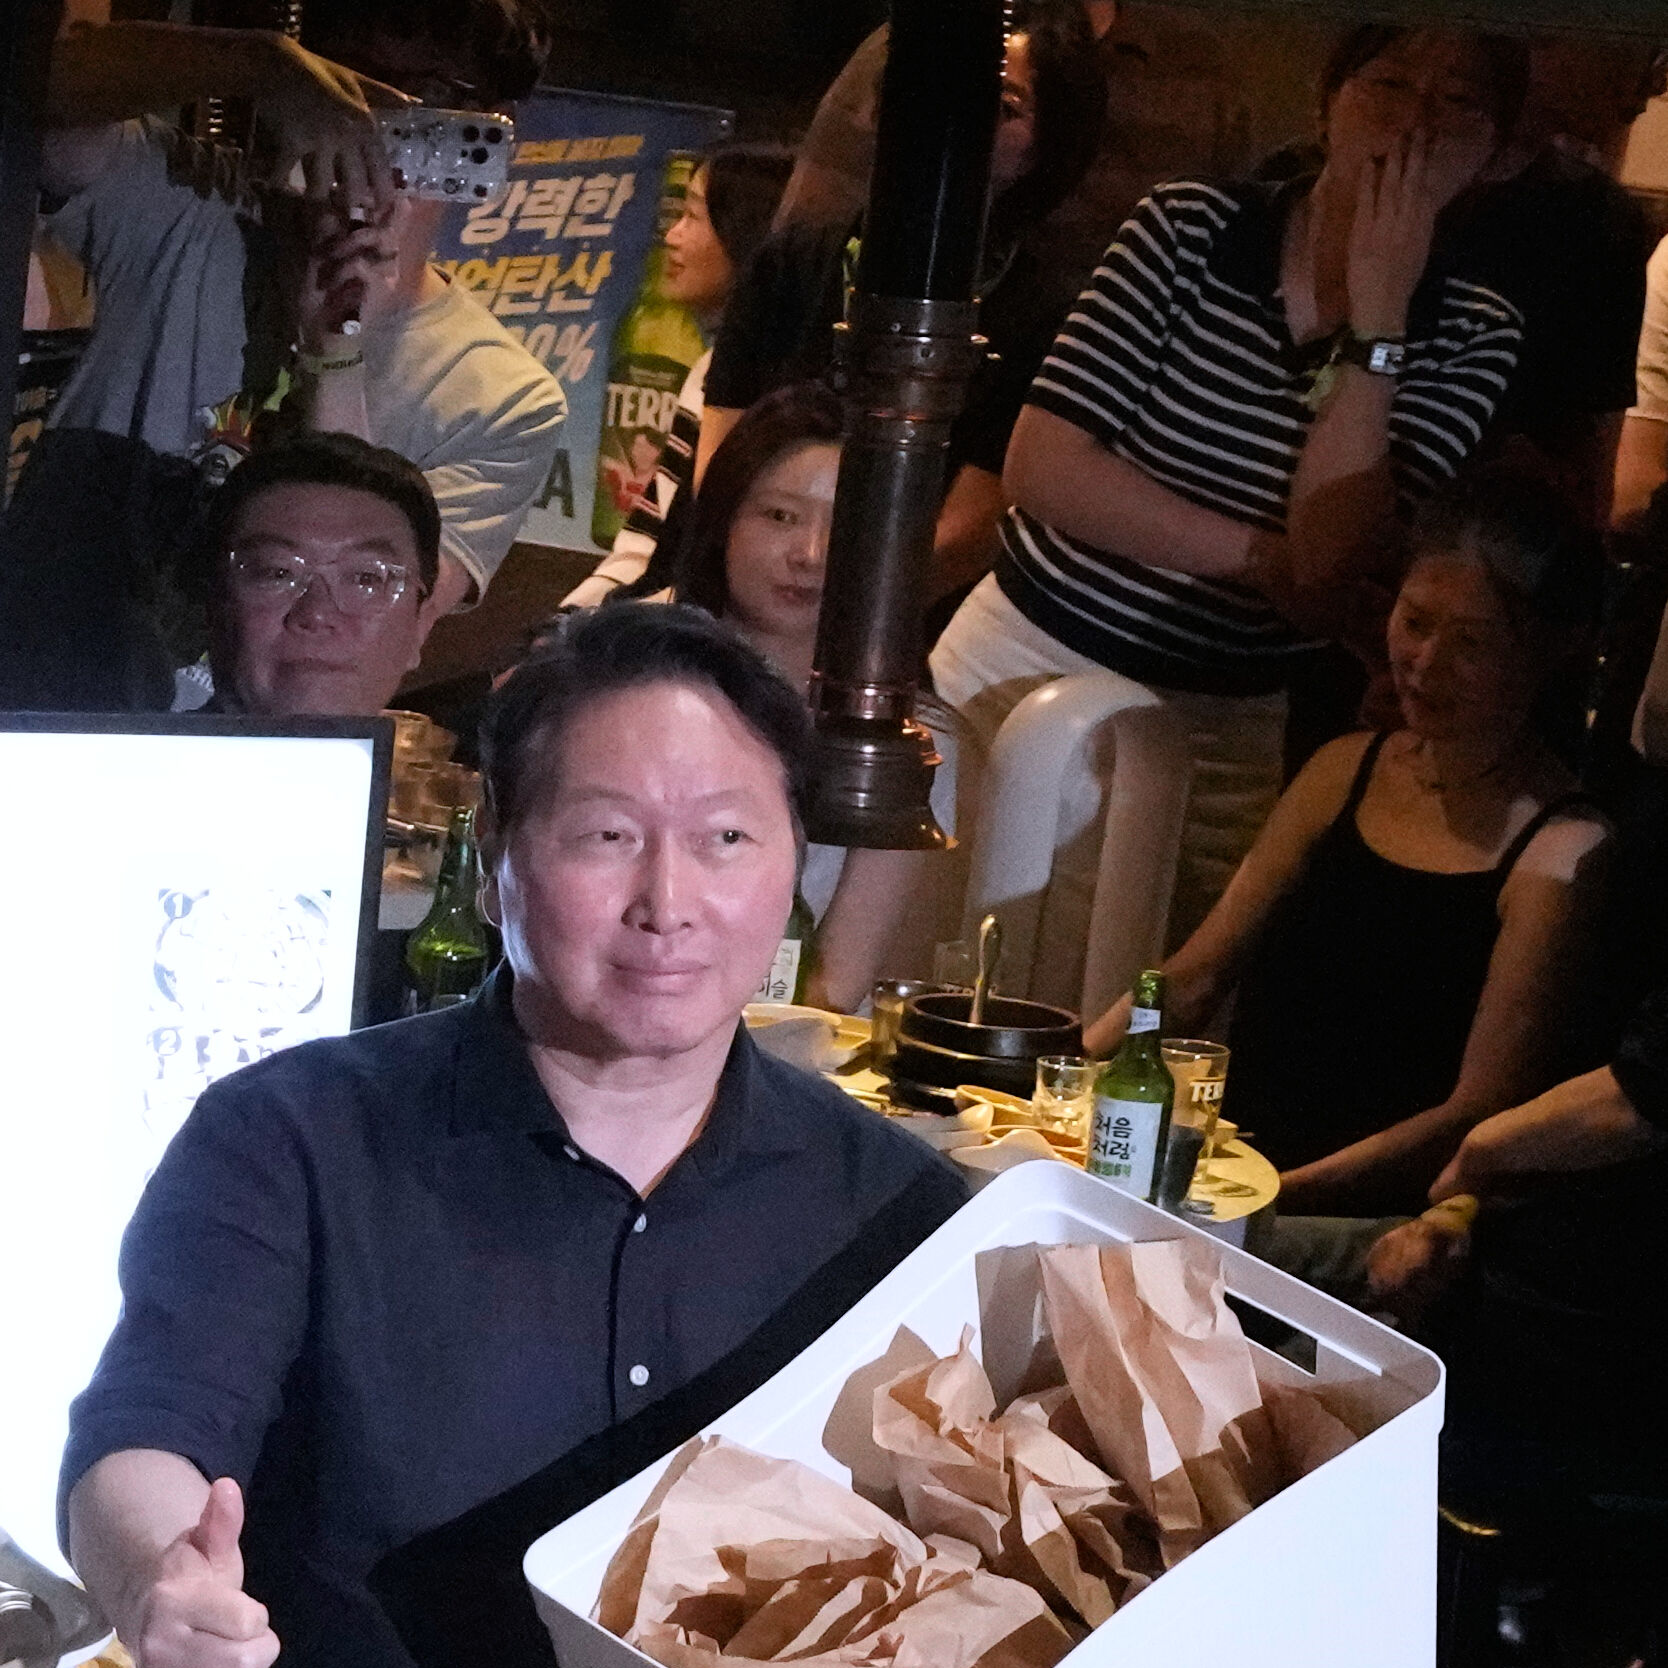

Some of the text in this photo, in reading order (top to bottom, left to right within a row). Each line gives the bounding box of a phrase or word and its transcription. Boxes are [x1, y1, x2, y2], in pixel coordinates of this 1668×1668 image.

[460, 172, 637, 246] 강력한
[607, 383, 679, 434] TERR
[1096, 1112, 1133, 1137] 처음
[1093, 1135, 1130, 1160] 처럼
